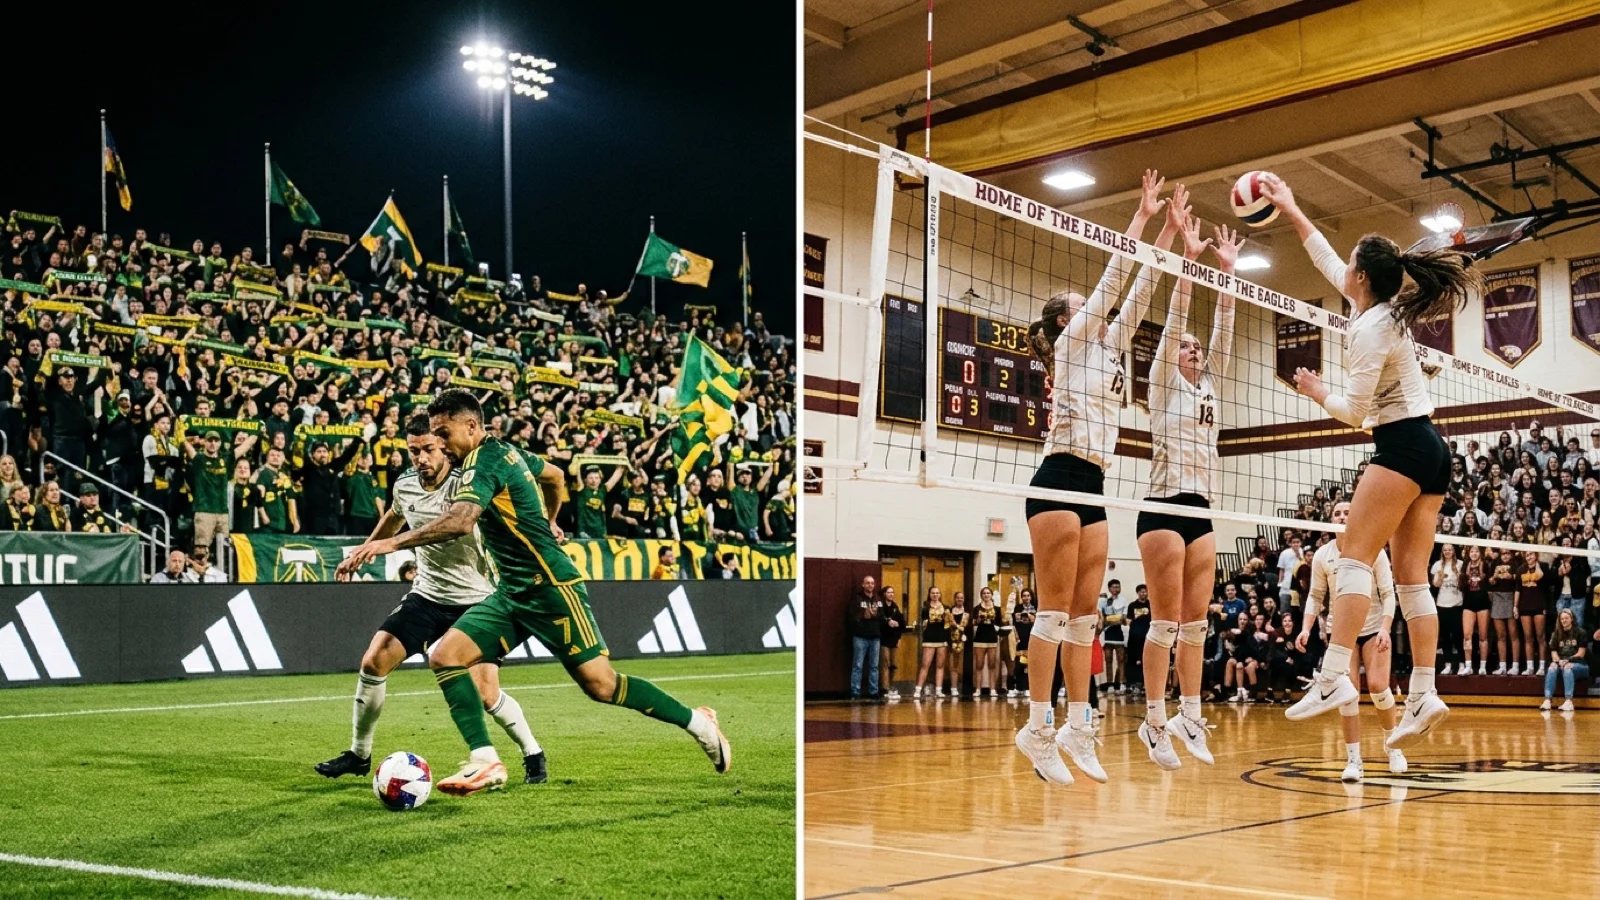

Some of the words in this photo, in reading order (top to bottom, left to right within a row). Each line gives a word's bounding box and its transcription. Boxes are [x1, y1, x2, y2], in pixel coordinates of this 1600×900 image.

[976, 182, 1022, 214] HOME
[1027, 202, 1046, 221] OF
[1051, 210, 1080, 234] THE
[1084, 222, 1137, 255] EAGLES
[1217, 273, 1231, 289] OF
[1235, 278, 1255, 298] THE
[963, 360, 975, 384] 0
[999, 369, 1009, 389] 2
[951, 395, 961, 414] 0
[969, 399, 979, 416] 3
[1198, 403, 1214, 427] 18
[1027, 409, 1036, 427] 5
[553, 617, 571, 644] 7
